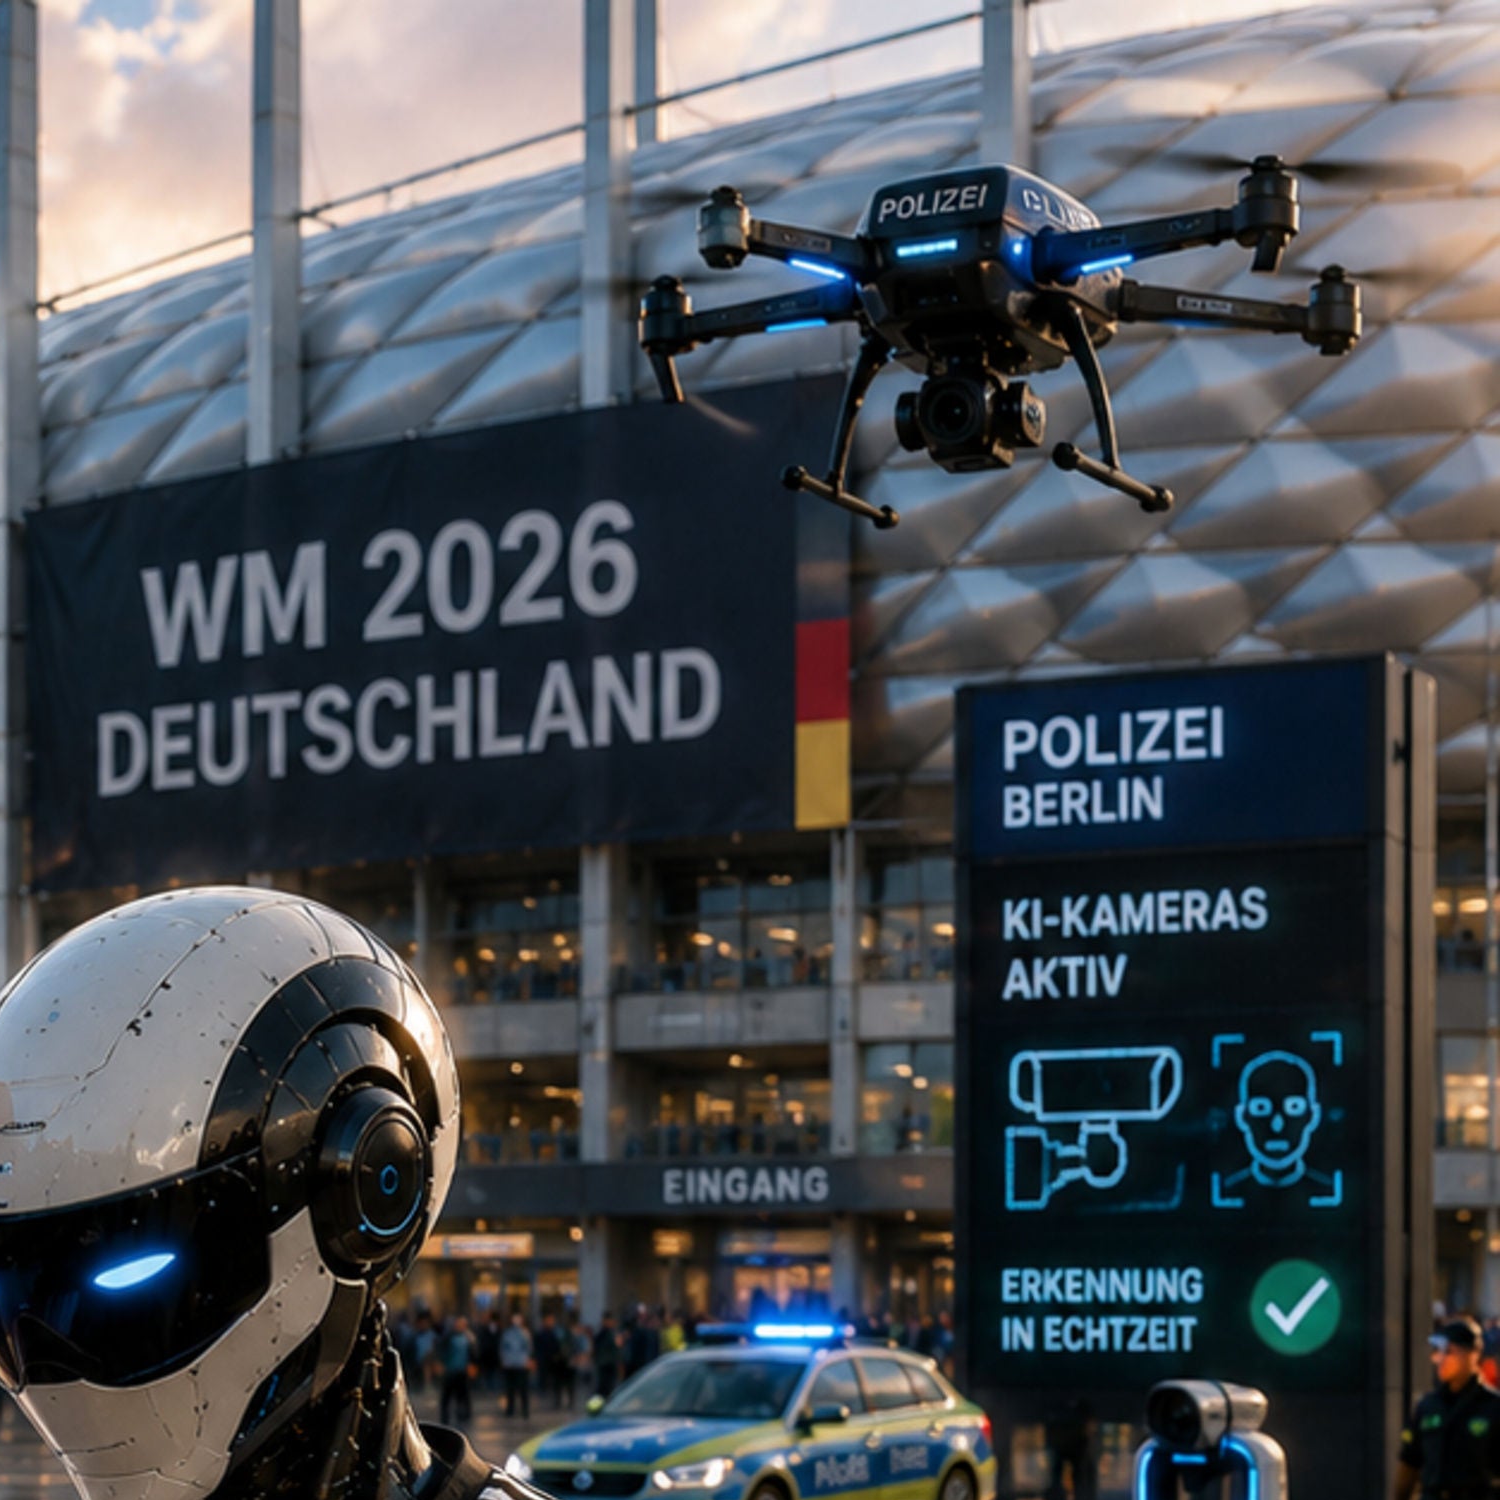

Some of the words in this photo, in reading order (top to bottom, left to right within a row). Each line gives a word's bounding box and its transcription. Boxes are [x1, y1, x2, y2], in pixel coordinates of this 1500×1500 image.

[878, 184, 988, 223] POLIZEI
[143, 542, 324, 666] WM
[364, 501, 636, 640] 2026
[98, 647, 721, 797] DEUTSCHLAND
[1005, 707, 1222, 770] POLIZEI
[1004, 777, 1162, 827] BERLIN
[1005, 887, 1267, 939] KI-KAMERAS
[1003, 955, 1126, 999] AKTIV
[665, 1167, 828, 1202] EINGANG
[1003, 1268, 1202, 1302] ERKENNUNG
[1003, 1318, 1034, 1350] IN
[1044, 1317, 1197, 1351] ECHTZEIT
